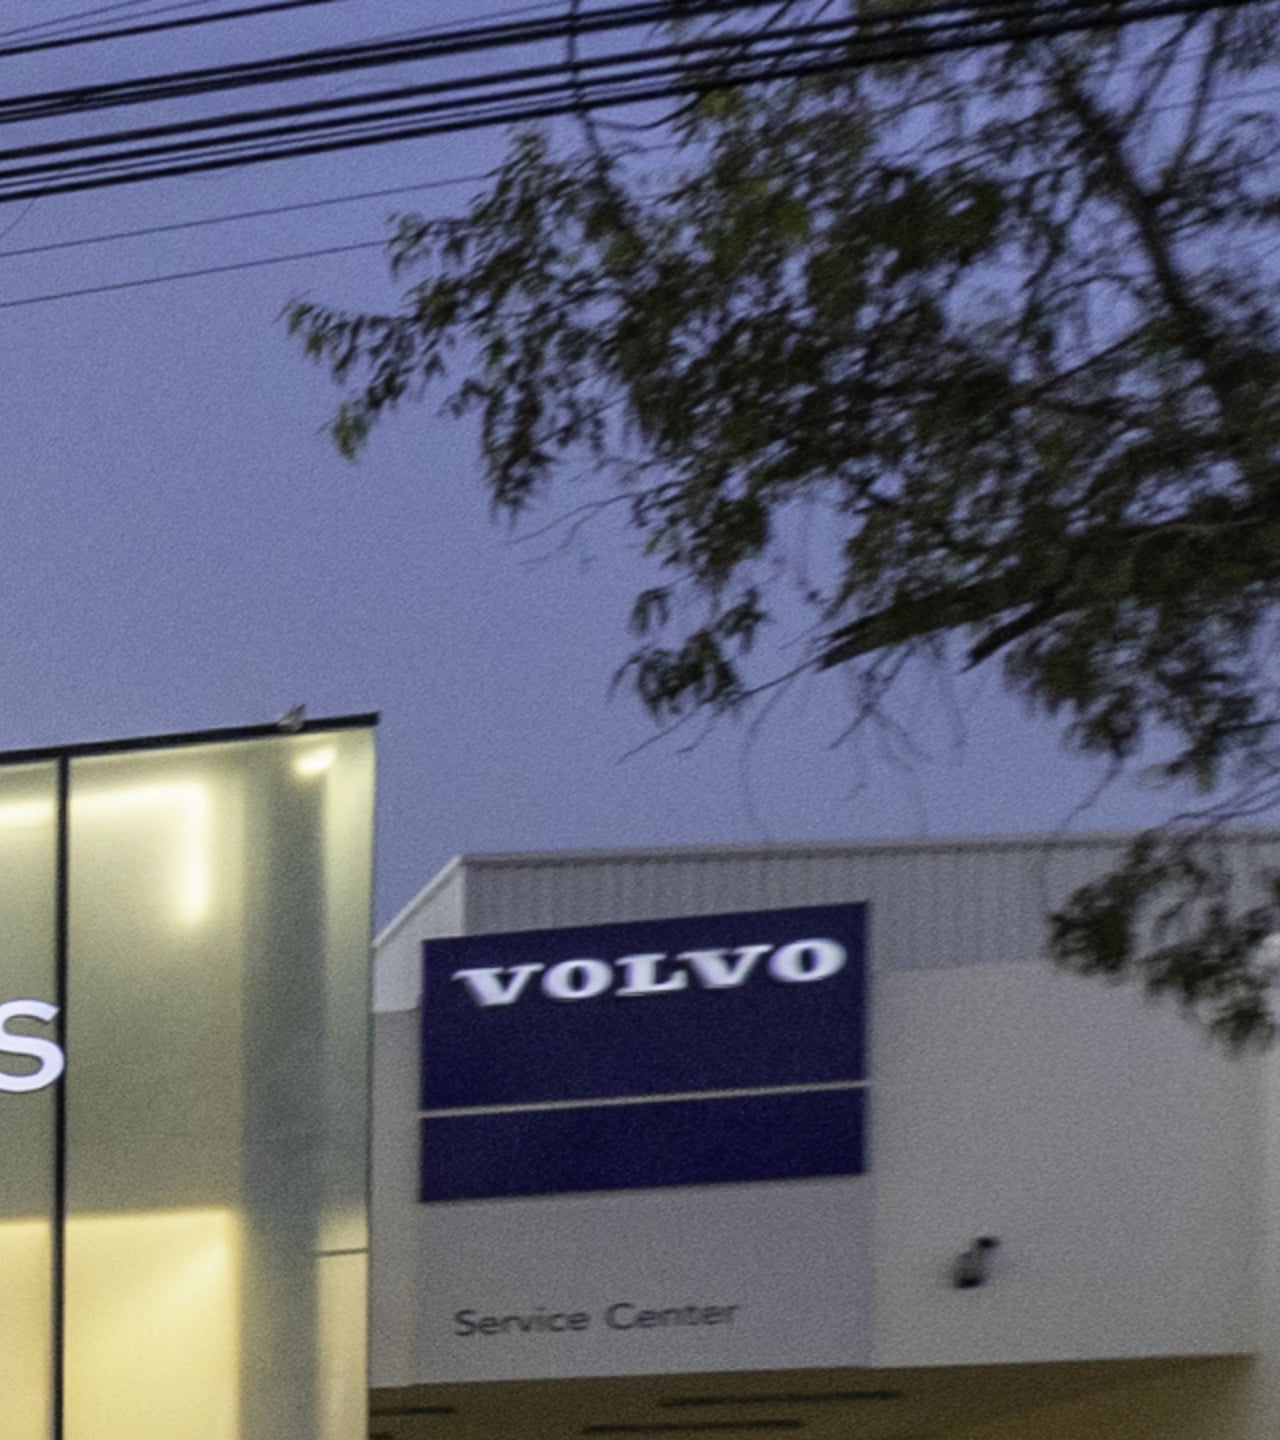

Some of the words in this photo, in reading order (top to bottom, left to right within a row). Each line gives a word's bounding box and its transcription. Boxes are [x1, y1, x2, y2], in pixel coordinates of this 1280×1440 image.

[453, 938, 848, 1008] VOLVO
[452, 1307, 591, 1338] Service
[603, 1301, 741, 1332] Center
